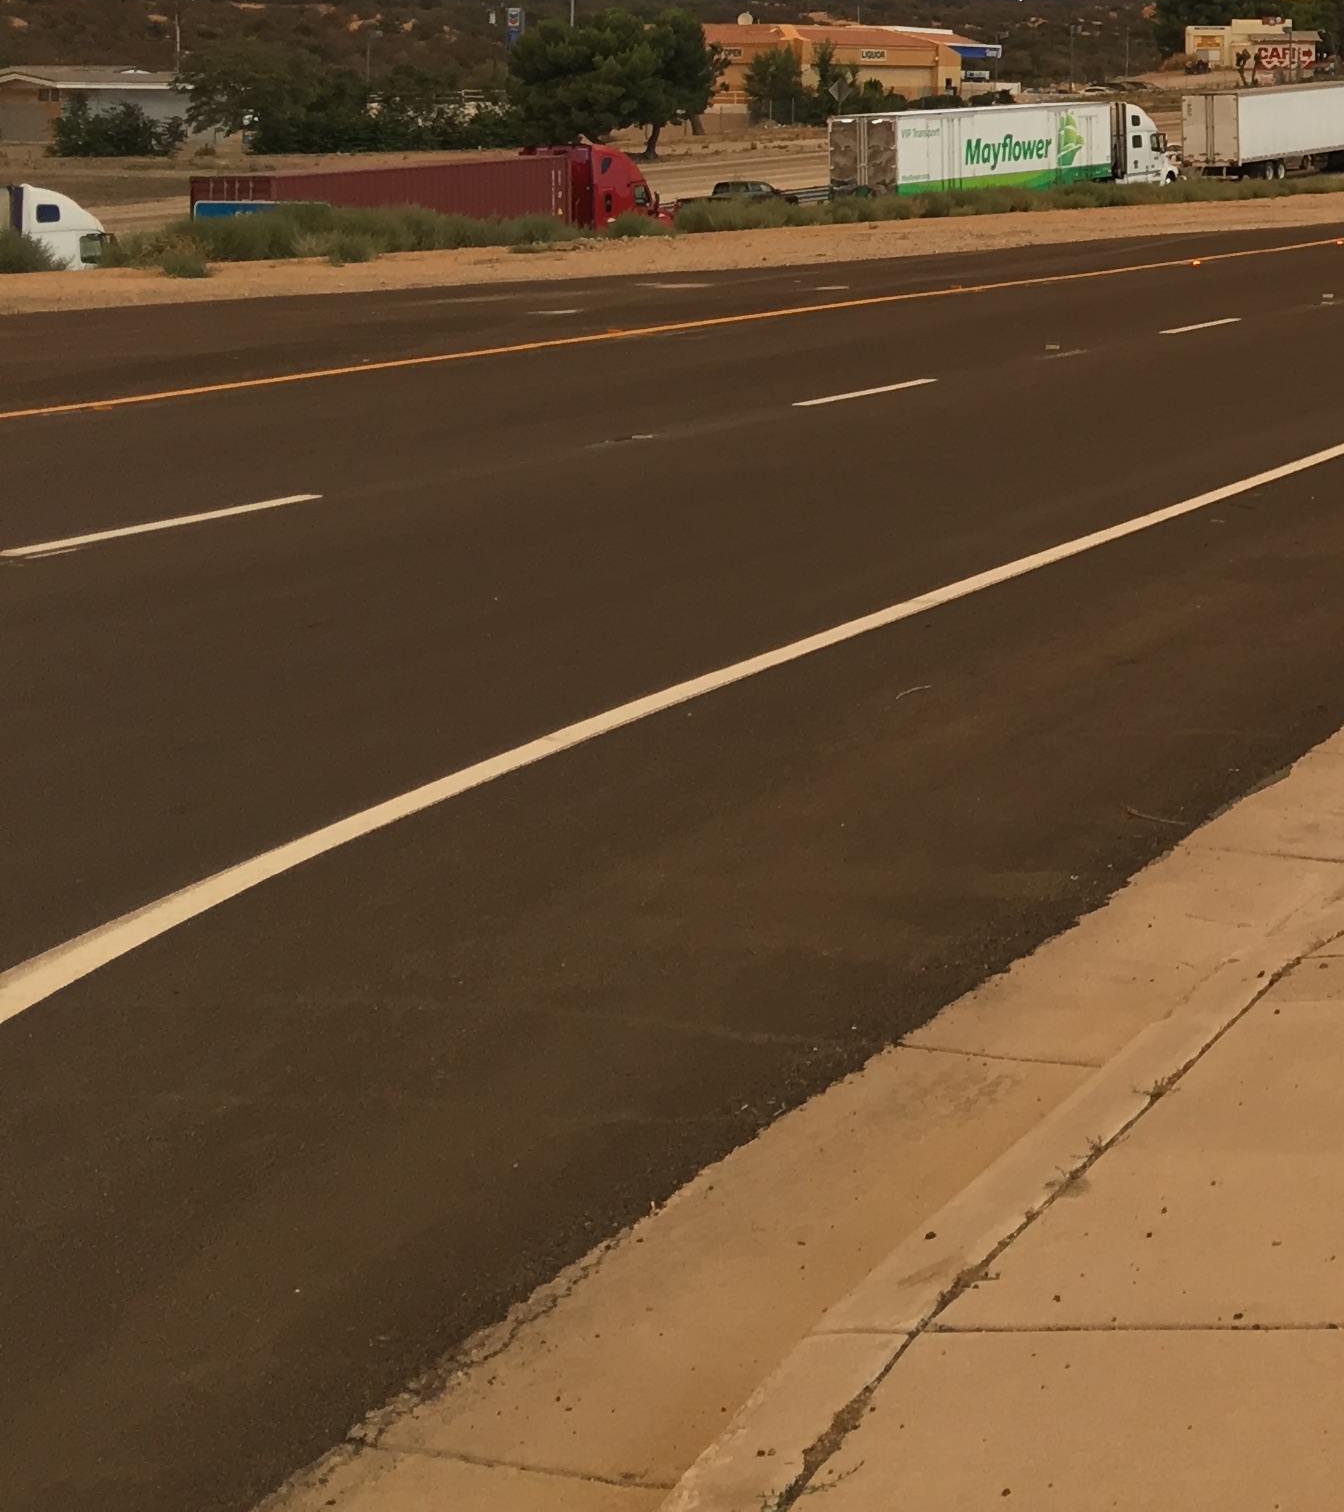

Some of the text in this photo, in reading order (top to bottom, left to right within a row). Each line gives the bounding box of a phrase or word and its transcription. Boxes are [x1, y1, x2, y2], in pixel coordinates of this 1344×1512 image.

[724, 48, 743, 57] OPEN
[861, 49, 886, 59] LIQUOR
[901, 127, 940, 138] VIP Transport
[965, 133, 1052, 170] Mayflower
